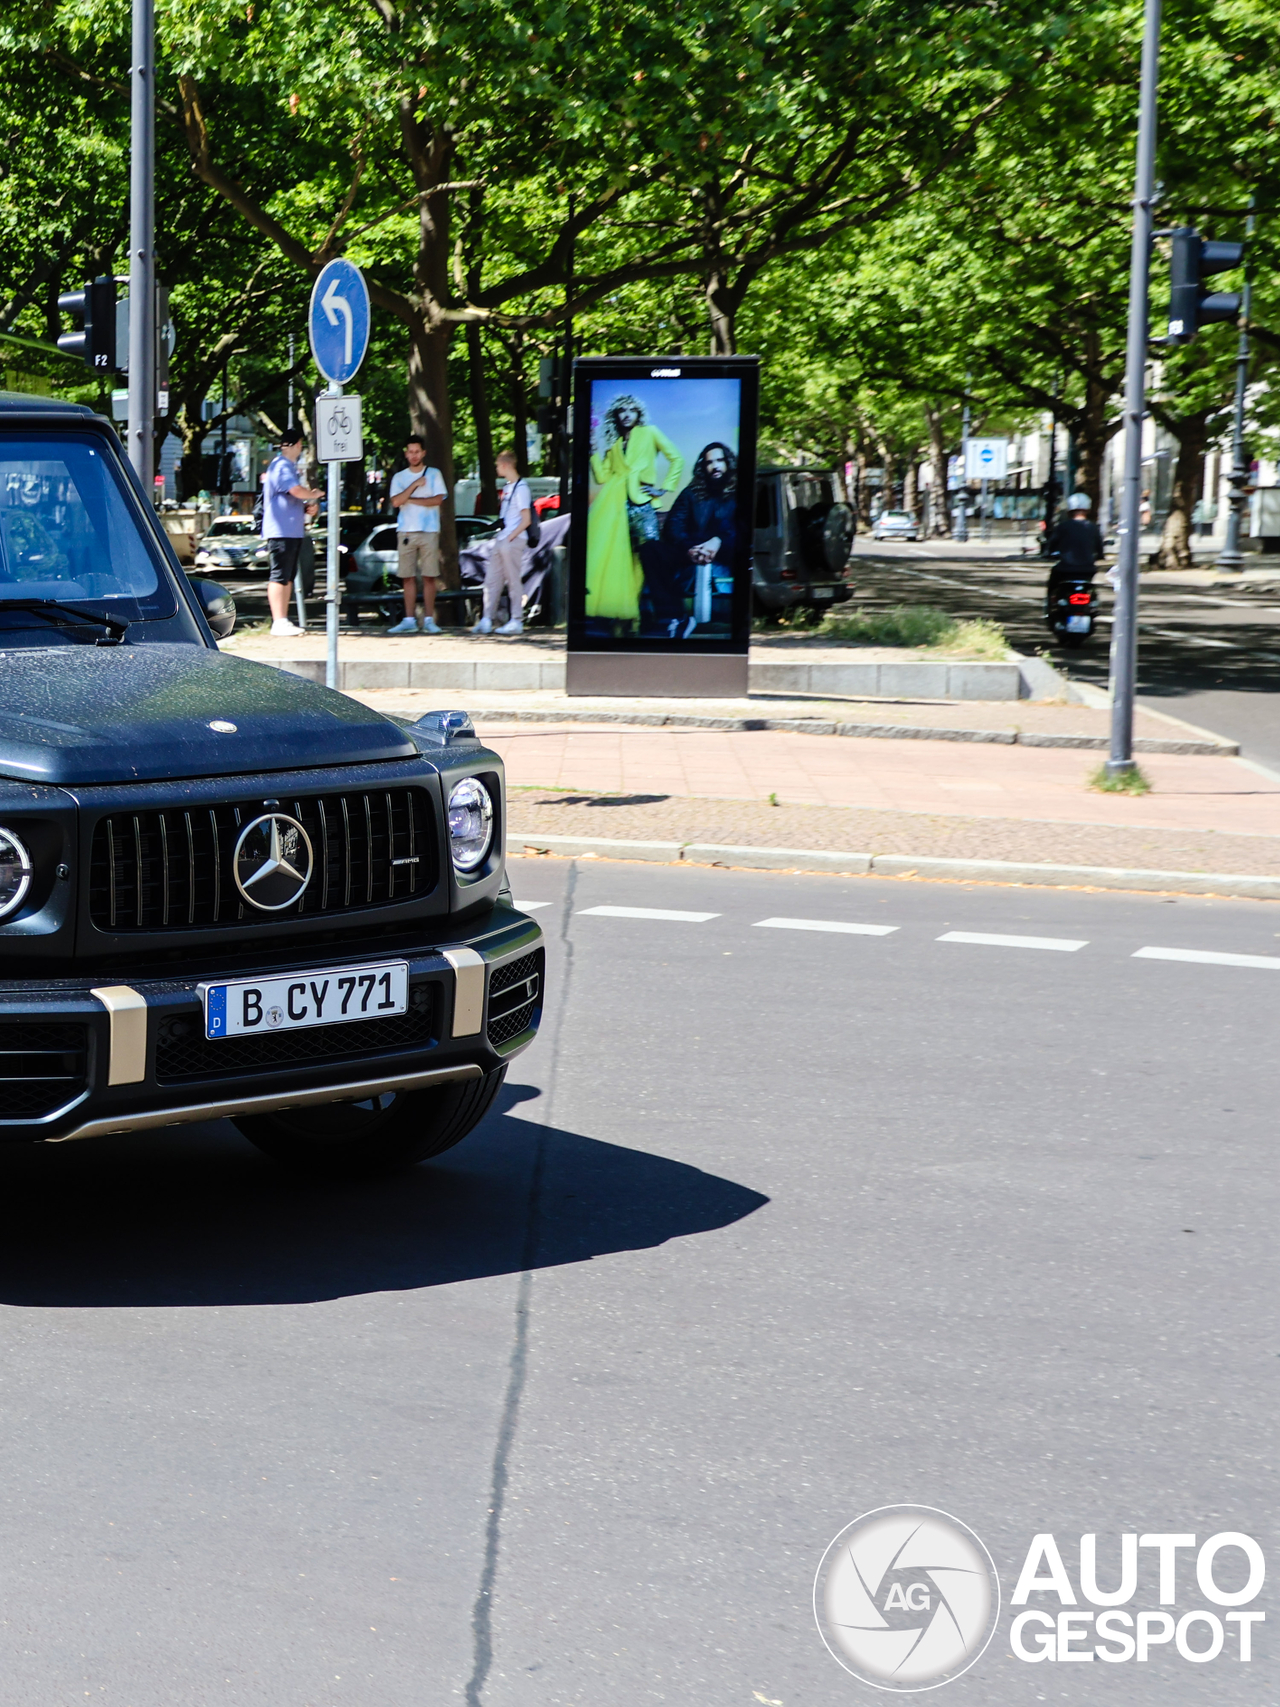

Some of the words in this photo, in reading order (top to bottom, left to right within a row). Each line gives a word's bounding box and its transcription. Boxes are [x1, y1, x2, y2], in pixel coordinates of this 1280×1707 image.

[95, 354, 108, 366] F2
[334, 439, 348, 453] frei
[402, 856, 420, 864] AMG
[243, 988, 262, 1027] B
[288, 979, 329, 1021] CY
[338, 972, 395, 1014] 771
[213, 1017, 221, 1028] D
